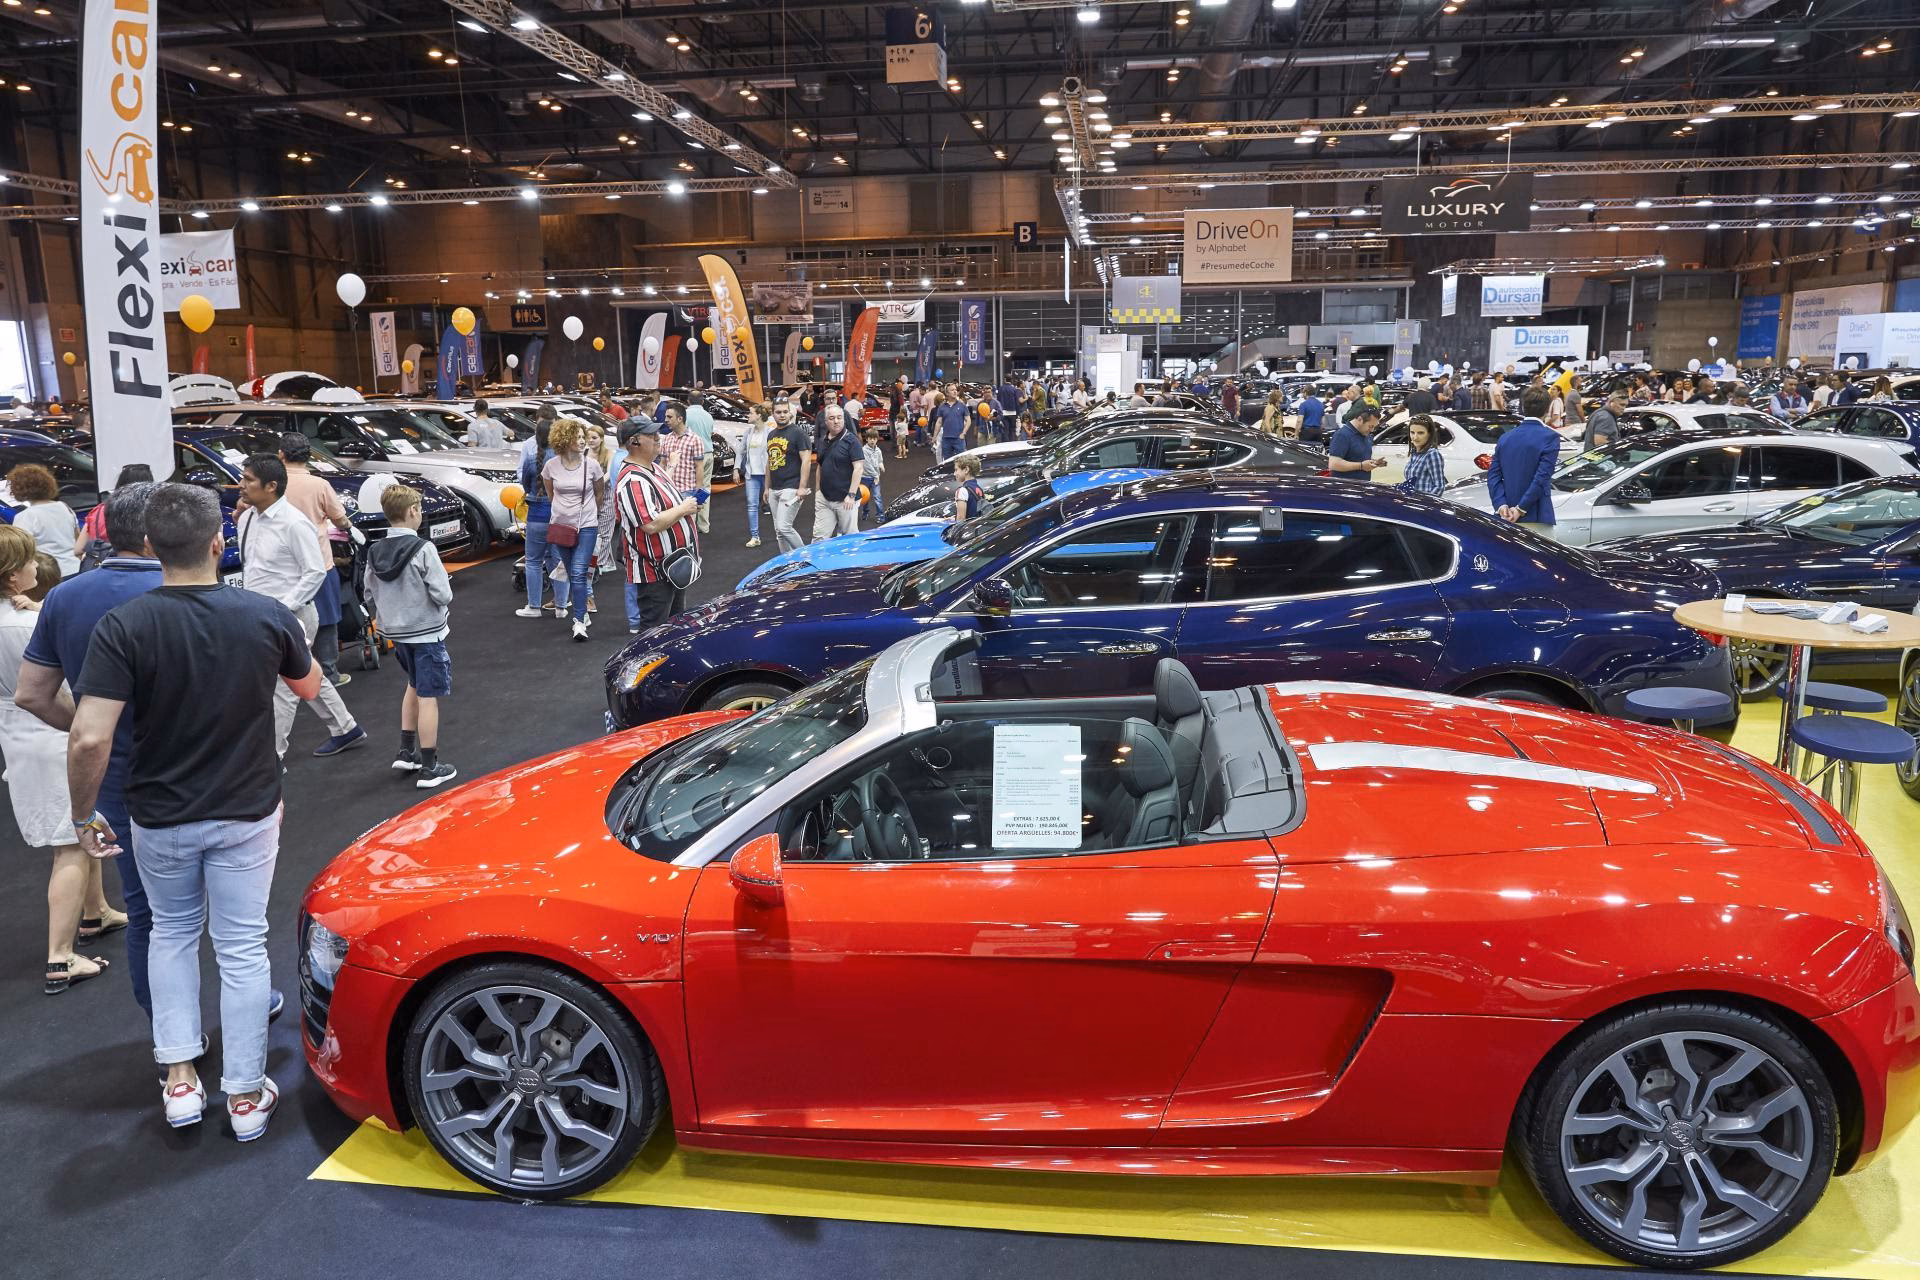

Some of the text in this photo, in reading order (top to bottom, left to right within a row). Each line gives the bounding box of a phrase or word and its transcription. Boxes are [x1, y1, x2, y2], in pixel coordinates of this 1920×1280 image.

[915, 13, 930, 39] 6
[1407, 202, 1506, 217] LUXURY
[1019, 225, 1032, 243] B
[1197, 219, 1280, 240] DriveOn
[1196, 243, 1247, 254] by Alphabet
[160, 257, 234, 275] exi car
[1200, 261, 1276, 272] #PresumedeCoche
[1483, 287, 1541, 304] Dursan
[103, 213, 162, 399] Flexi
[882, 303, 908, 313] VTRC
[1514, 328, 1569, 345] Dursan
[433, 527, 447, 536] Flexi
[229, 577, 243, 587] Fle
[637, 933, 670, 942] V10
